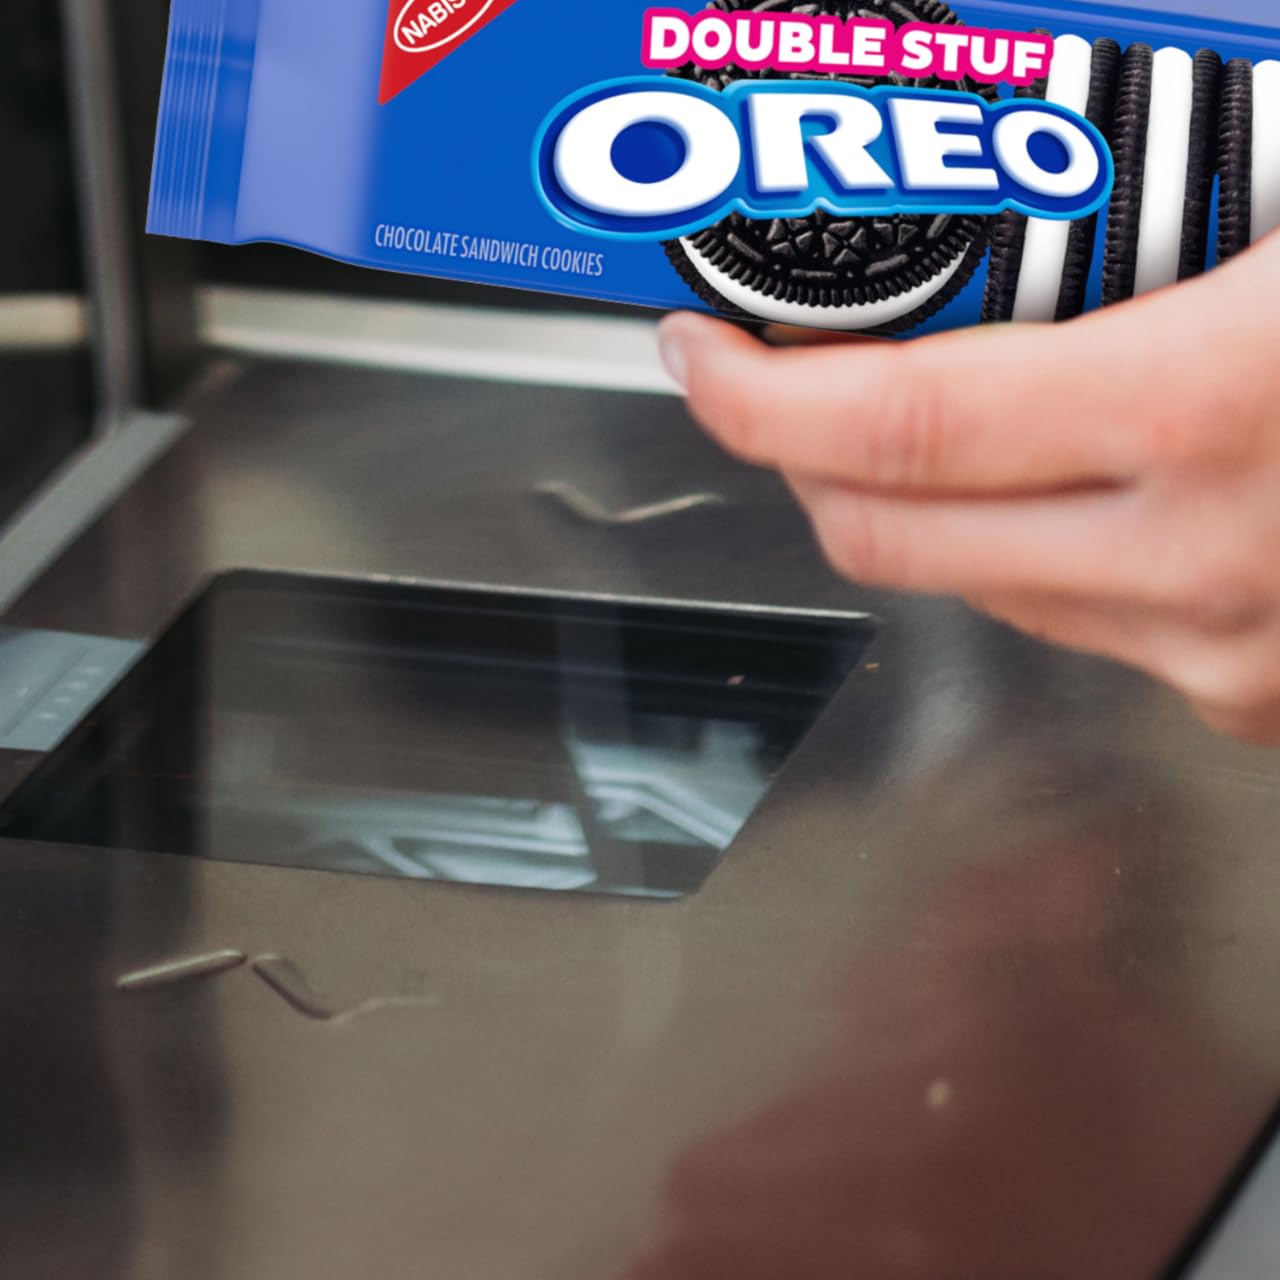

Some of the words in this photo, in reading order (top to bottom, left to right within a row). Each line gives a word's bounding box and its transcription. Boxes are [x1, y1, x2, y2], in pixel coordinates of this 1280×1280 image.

[649, 15, 886, 67] DOUBLE
[901, 29, 1046, 78] STUF
[553, 90, 1100, 218] OREO
[375, 224, 459, 257] CHOCOLATE
[460, 235, 539, 268] SANDWICH
[541, 247, 604, 277] COOKIES
